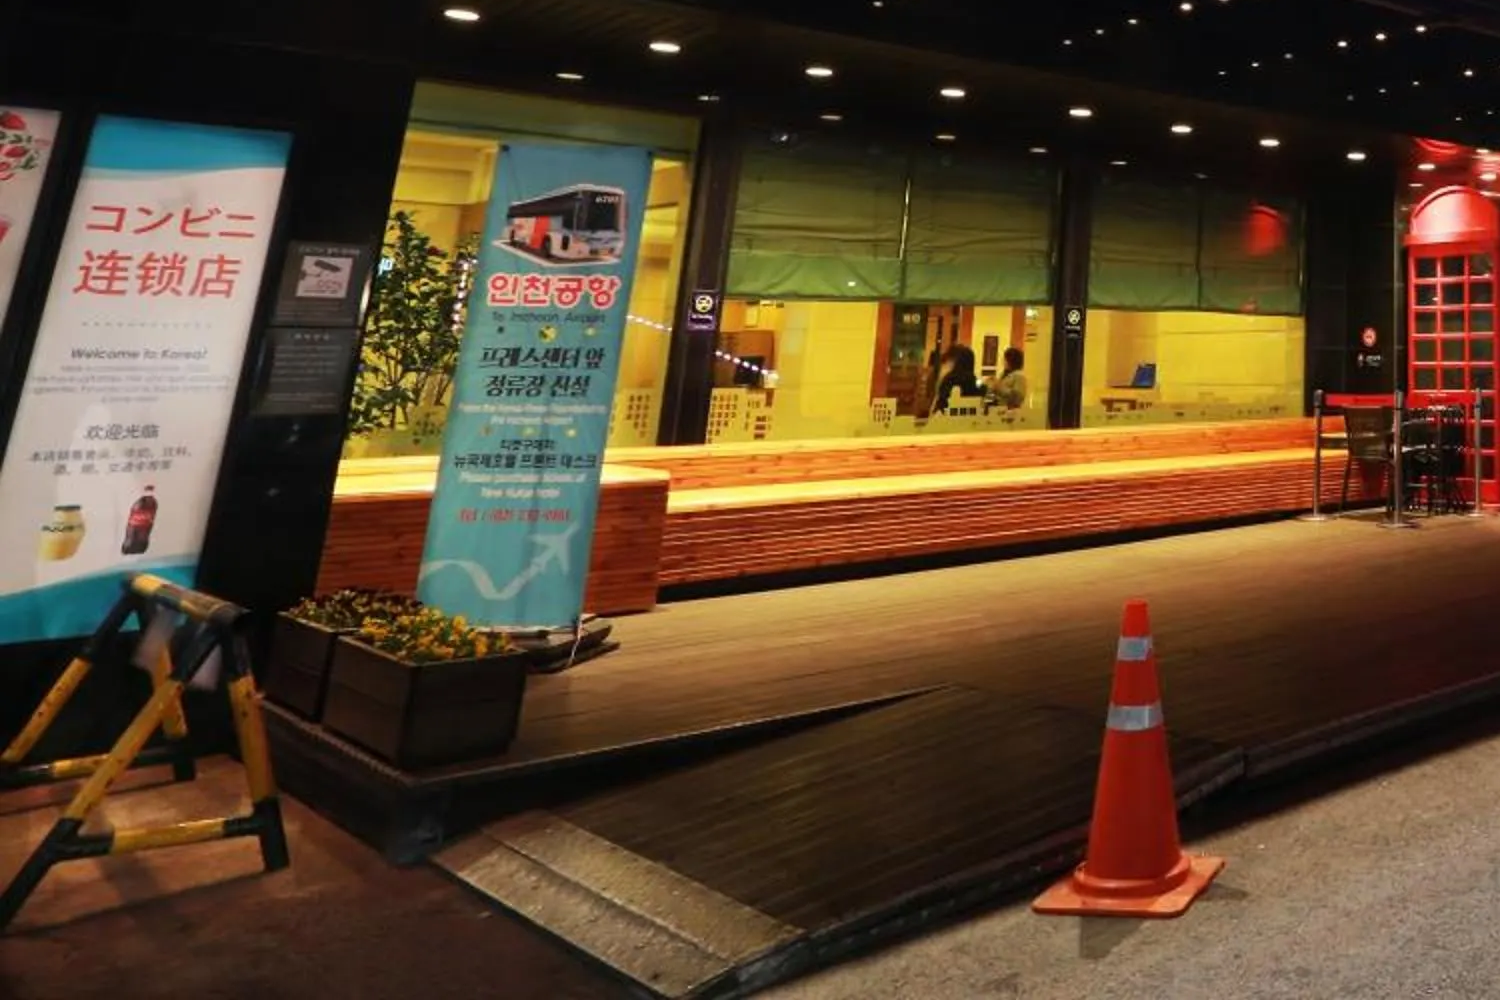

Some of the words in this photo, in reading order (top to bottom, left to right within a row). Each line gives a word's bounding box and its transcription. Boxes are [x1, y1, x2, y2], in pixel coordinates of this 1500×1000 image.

[85, 204, 257, 240] コンビニ
[72, 250, 242, 299] 连锁店
[488, 274, 621, 308] 인천공항
[71, 348, 140, 359] Welcome
[478, 346, 581, 369] 프레스센터
[486, 375, 545, 397] 정류장
[84, 423, 159, 440] 欢迎光临
